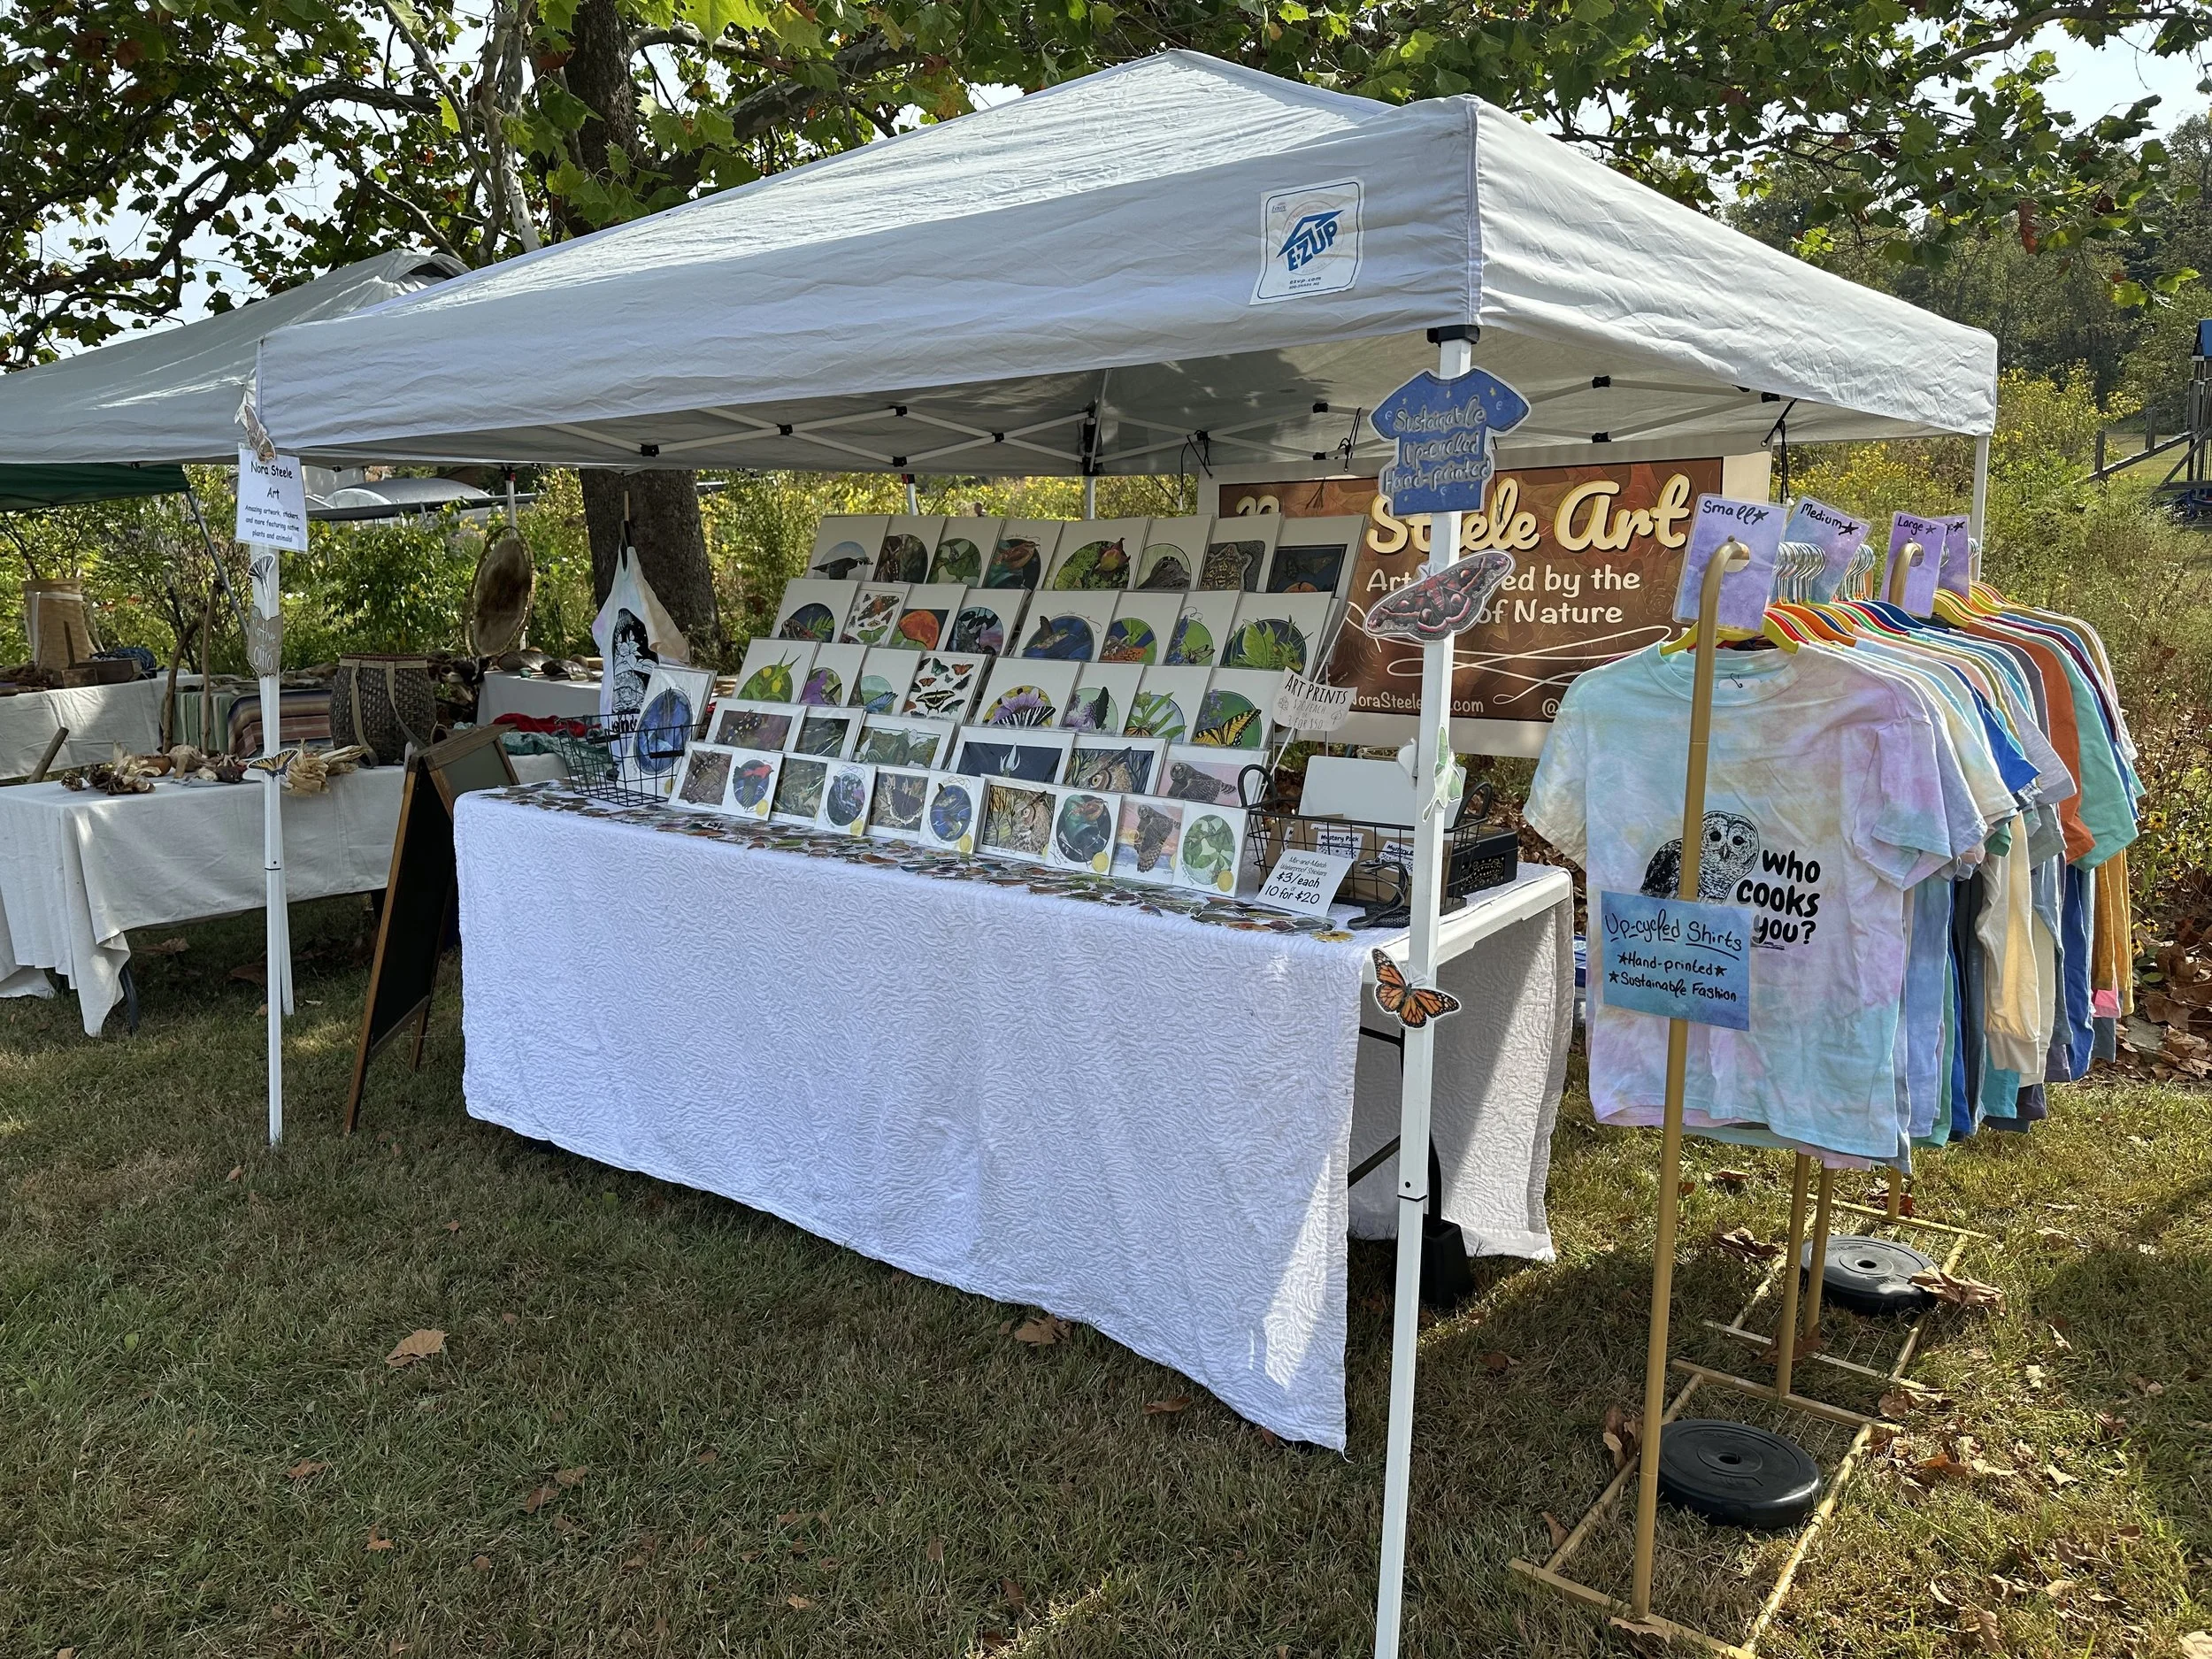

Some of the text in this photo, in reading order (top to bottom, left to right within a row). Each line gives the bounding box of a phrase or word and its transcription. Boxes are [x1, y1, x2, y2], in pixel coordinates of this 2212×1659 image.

[1394, 395, 1487, 433] Sustainable
[1403, 433, 1480, 470] Up-cycled
[250, 461, 294, 480] Nora Steele
[1384, 458, 1491, 492] Hand-printed
[266, 487, 280, 500] Art
[244, 504, 301, 520] Amazing artwork, stickers,
[1553, 472, 1691, 554] Art
[1701, 499, 1757, 525] Small
[1800, 503, 1843, 530] Medium
[266, 519, 287, 531] featuring
[1897, 515, 1924, 536] Large
[1365, 568, 1412, 593] Art
[1544, 565, 1582, 598] by
[1590, 564, 1641, 592] the
[1477, 598, 1624, 625] of Nature
[1284, 673, 1349, 705] ART PRINTS
[1293, 698, 1327, 715] $20/EACH
[1286, 714, 1325, 730] 3 FOR $50
[1279, 864, 1328, 877] Waterproof Stickers
[1288, 856, 1328, 869] Mix-and-Match
[1276, 872, 1321, 889] $3/each
[1264, 885, 1320, 904] 10 for $20
[1604, 908, 1742, 952] Up-cycled Shirts
[1627, 951, 1713, 975] Hand-printed
[1620, 972, 1737, 1002] Sustainable Fashion
